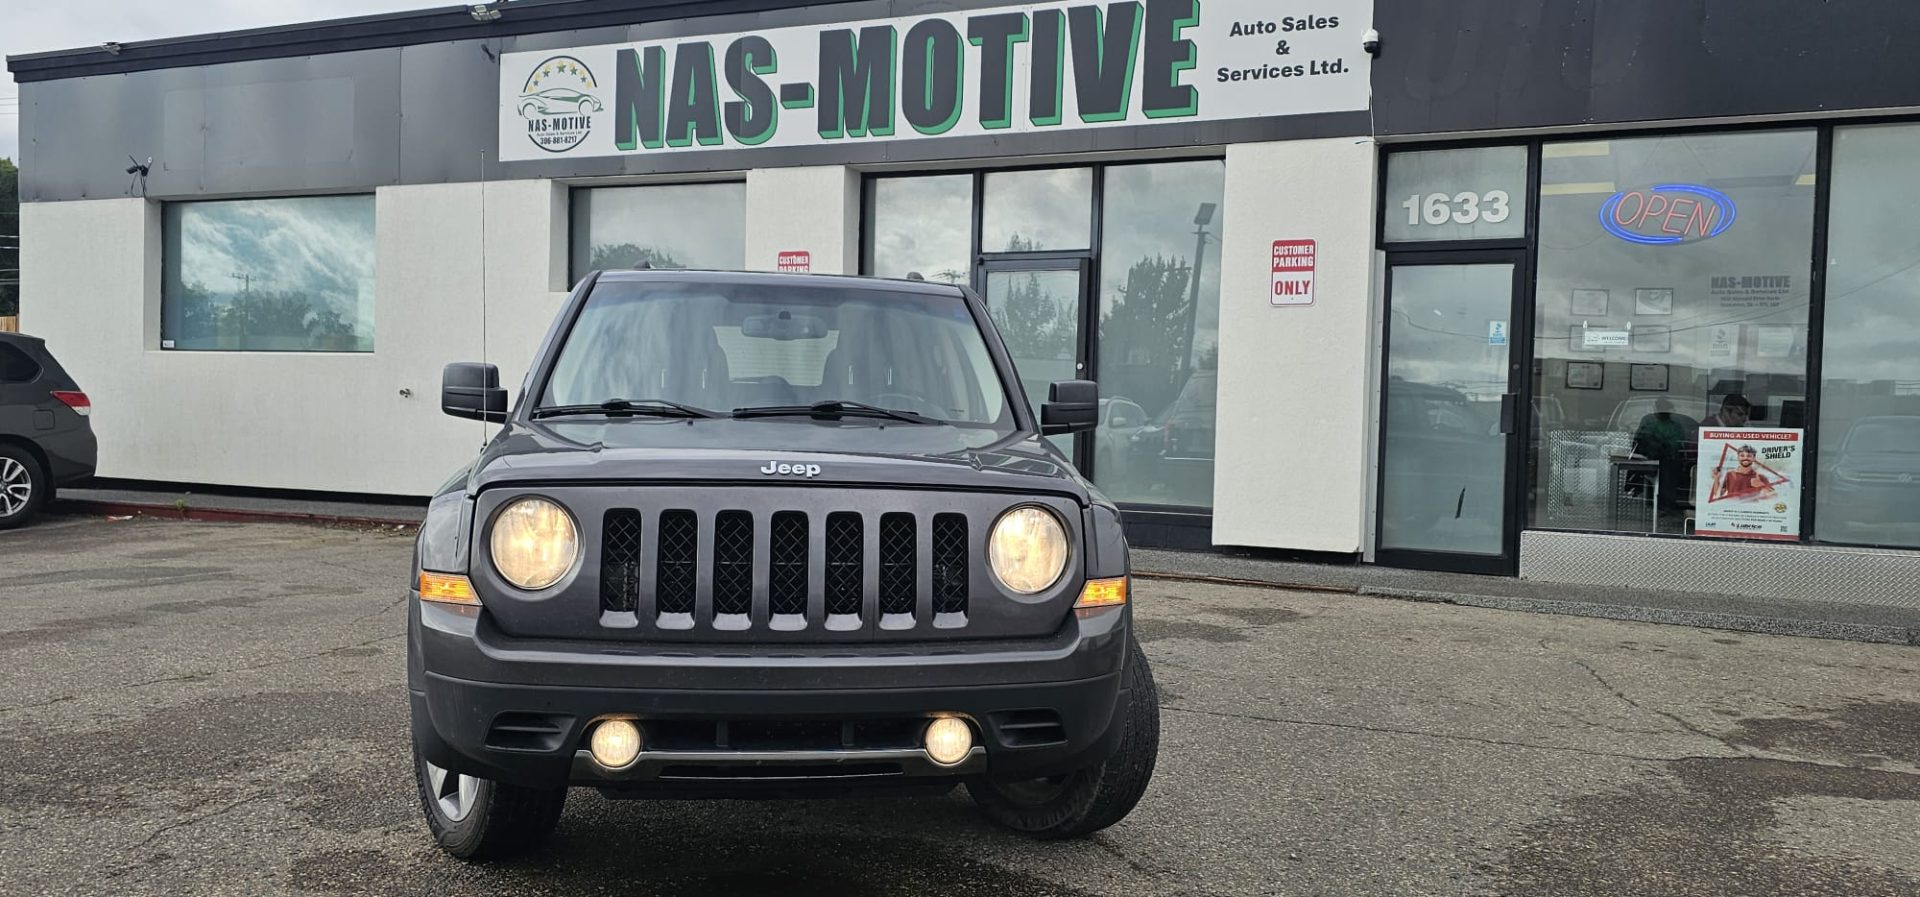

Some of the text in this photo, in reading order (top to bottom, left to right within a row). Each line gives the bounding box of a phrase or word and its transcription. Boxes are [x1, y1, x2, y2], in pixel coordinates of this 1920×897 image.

[1229, 14, 1339, 37] Auto Sales
[1275, 39, 1291, 55] &
[615, 0, 1199, 150] NAS-MOTIVE
[1217, 58, 1349, 82] Services Ltd.
[528, 116, 591, 132] NAS-MOTIVE
[1402, 190, 1509, 225] 1633
[1615, 191, 1717, 237] OPEN
[1273, 245, 1314, 255] CUSTOMER
[779, 255, 809, 265] CUSTOMER
[1273, 256, 1314, 268] PARKING
[1274, 280, 1311, 296] ONLY
[1711, 275, 1791, 288] NAS-MOTIVE
[1761, 445, 1796, 454] DRIVER'S
[1765, 452, 1792, 460] SHIELD
[760, 460, 821, 478] Jeep
